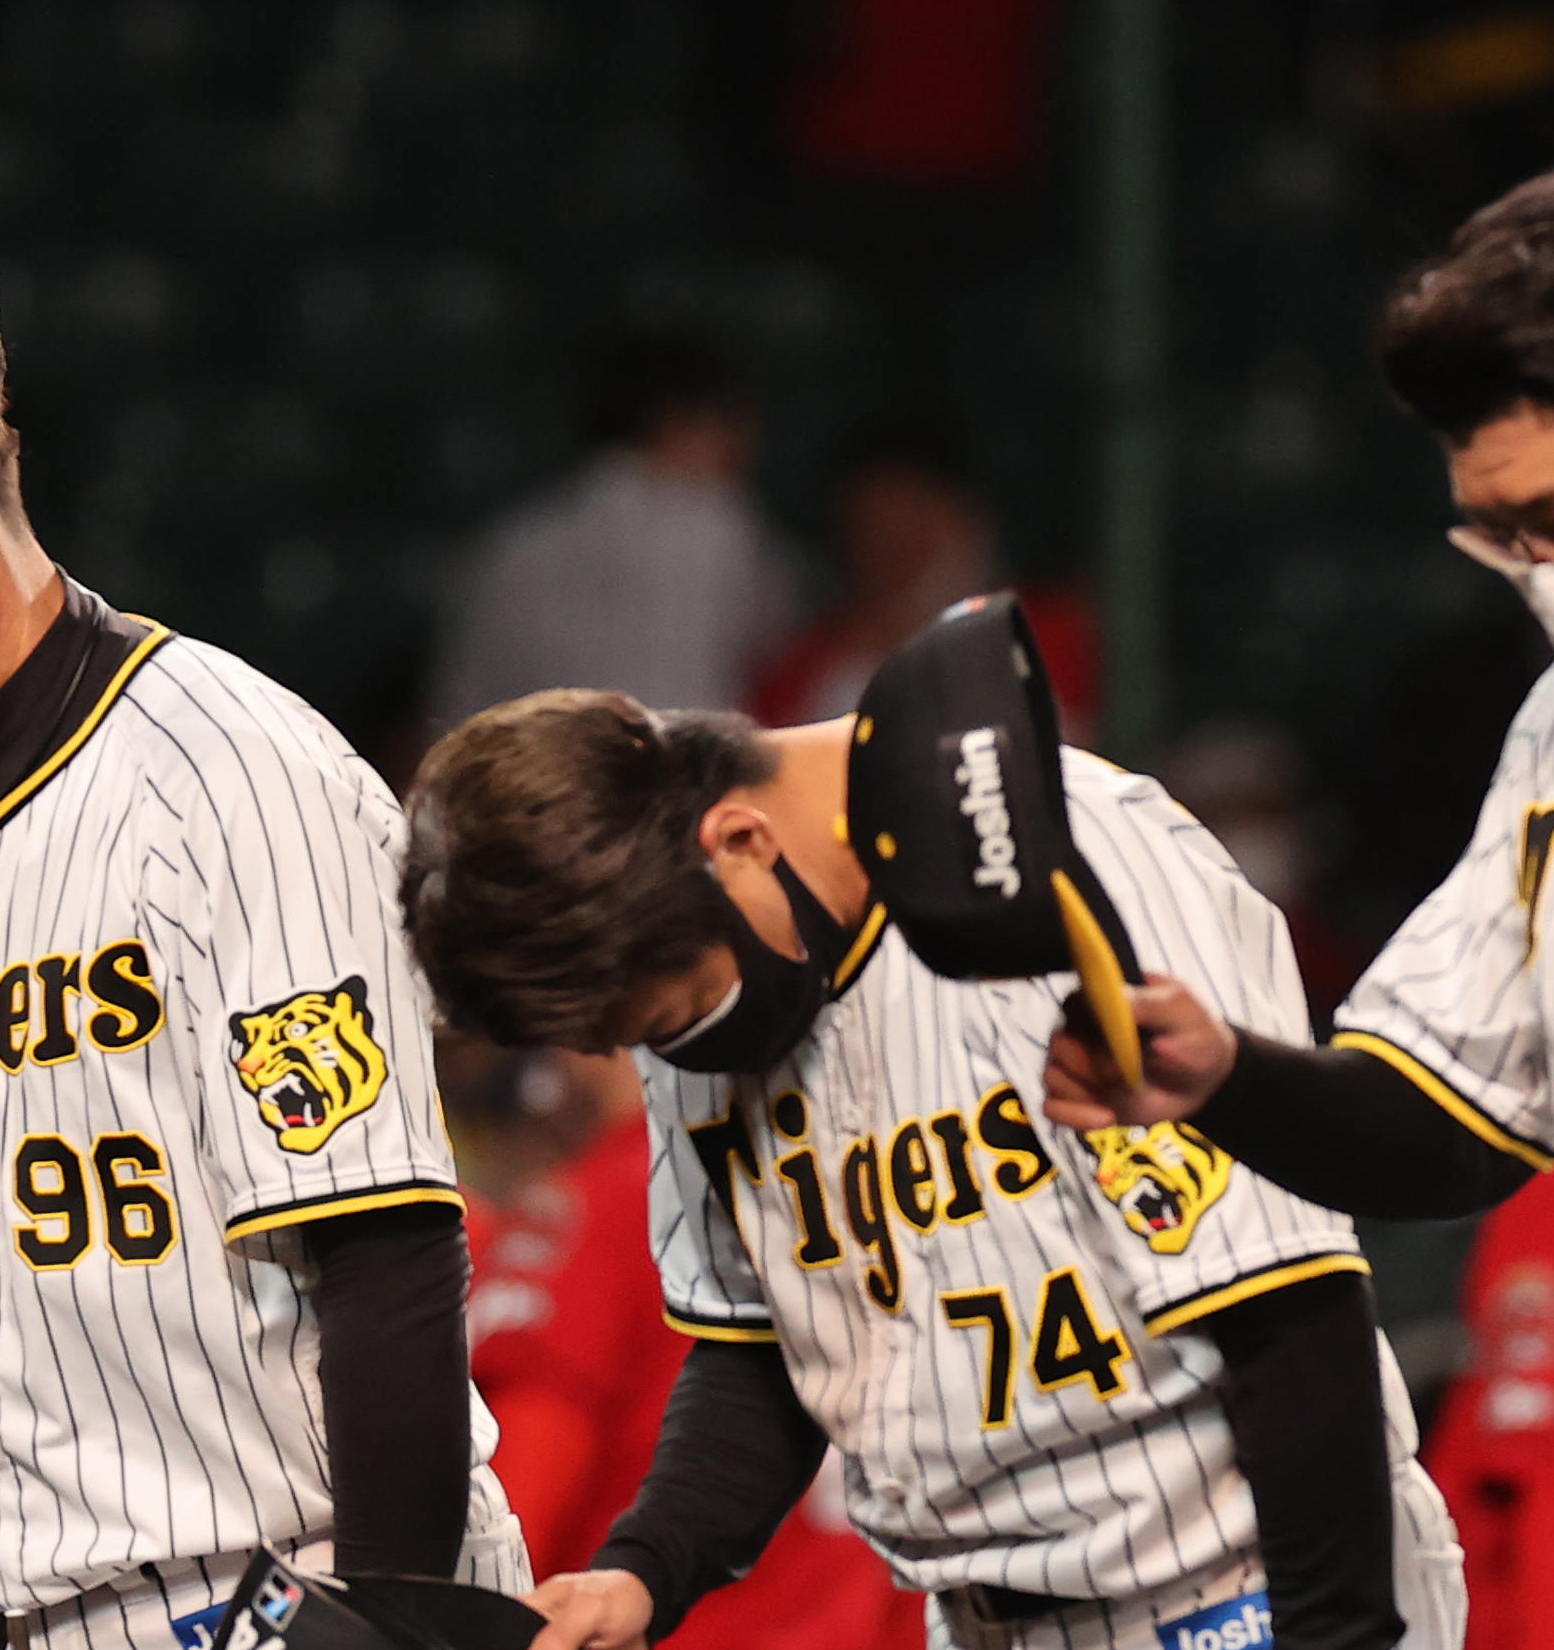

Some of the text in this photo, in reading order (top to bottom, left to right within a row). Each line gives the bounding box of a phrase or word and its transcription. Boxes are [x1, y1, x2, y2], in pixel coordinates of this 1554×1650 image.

[954, 727, 1021, 898] Joshin
[12, 1130, 179, 1272] 96
[680, 1081, 1056, 1316] Tigers
[940, 1265, 1131, 1430] 74
